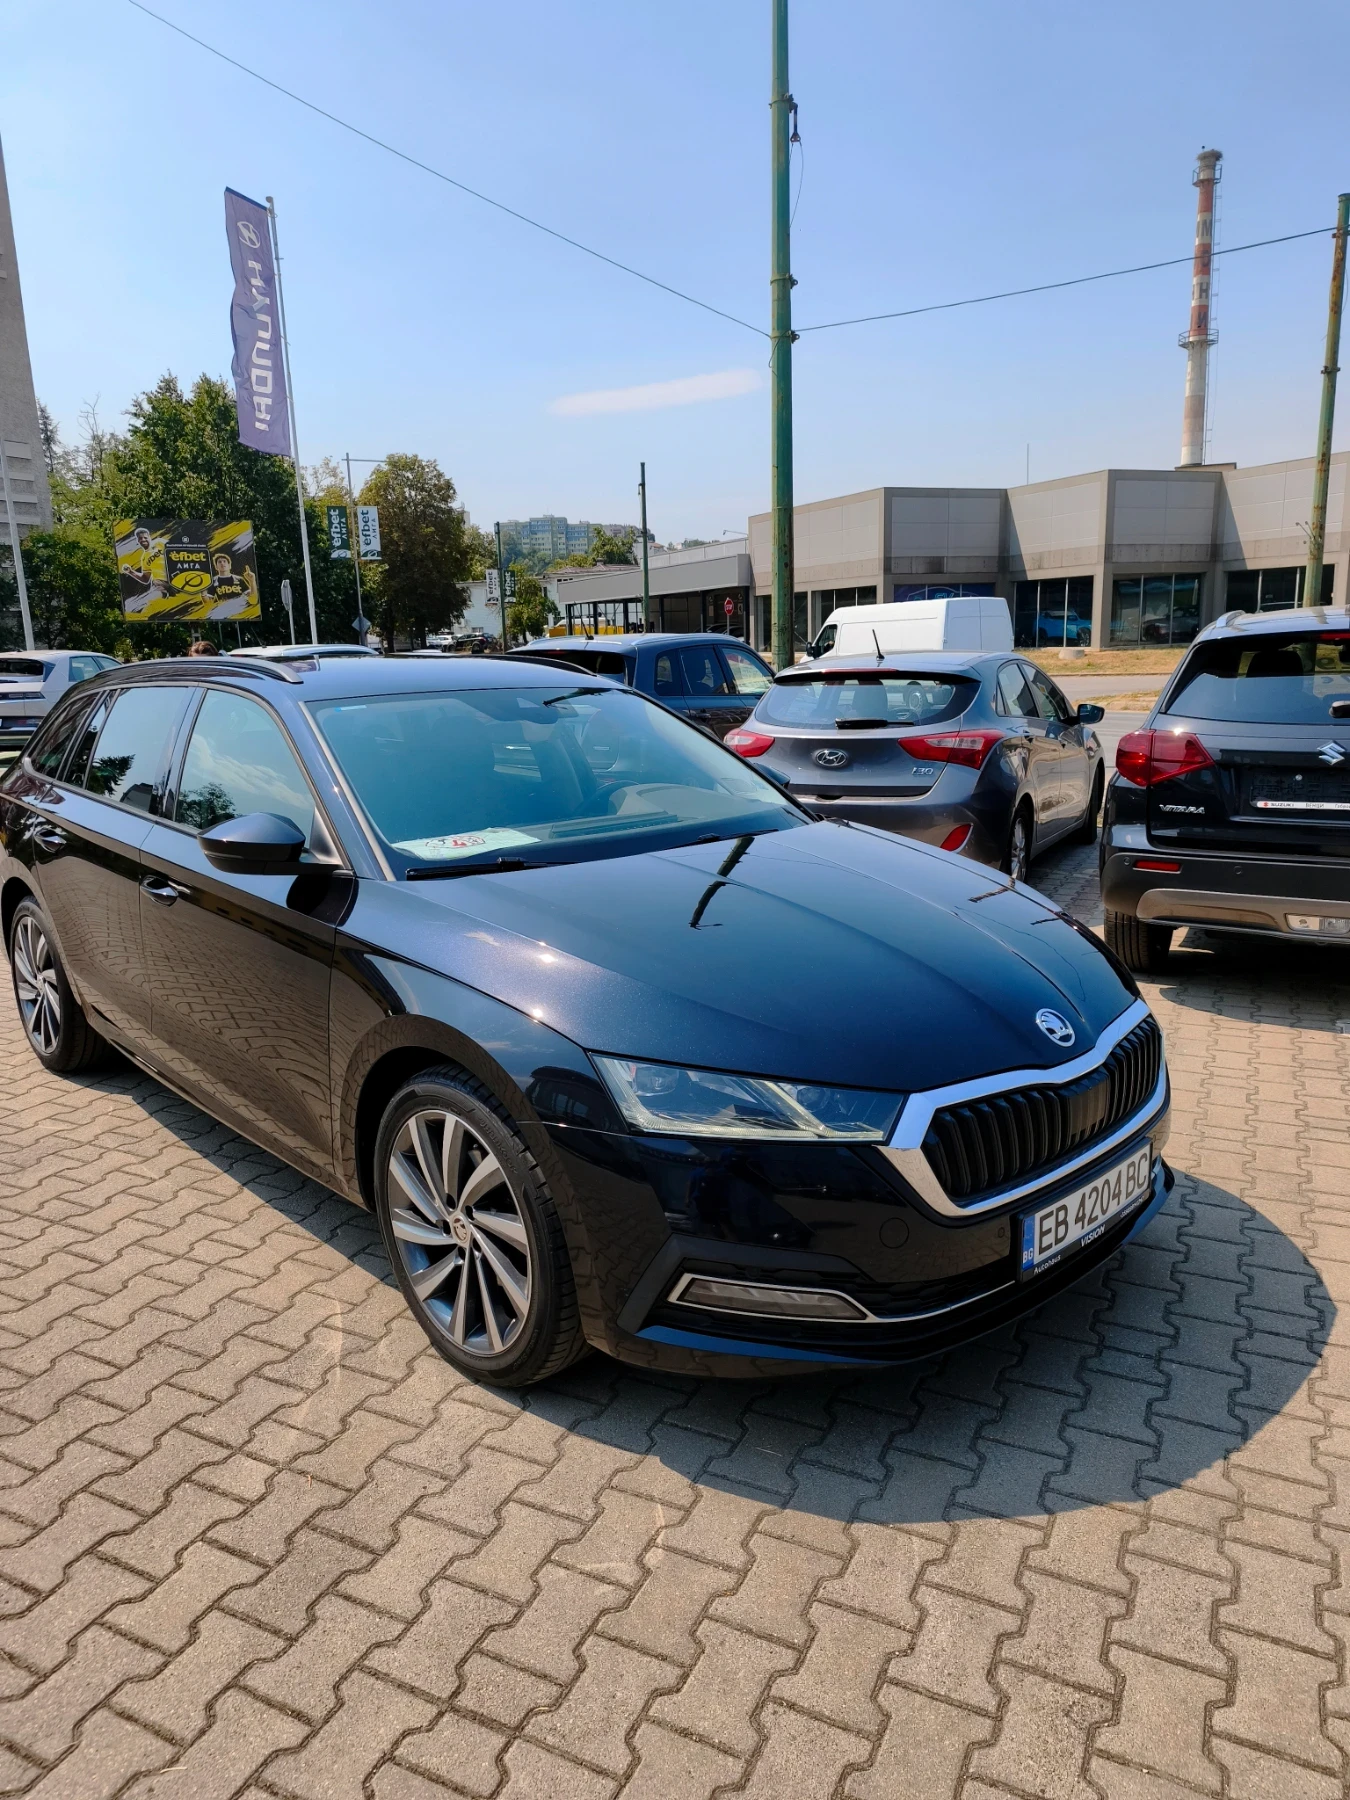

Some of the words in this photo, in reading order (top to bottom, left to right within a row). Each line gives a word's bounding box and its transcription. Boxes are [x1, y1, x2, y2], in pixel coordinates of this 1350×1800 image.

[329, 508, 342, 547] efbet
[361, 509, 372, 546] efbet
[169, 551, 206, 562] efbet
[216, 585, 242, 595] efbet
[1159, 804, 1205, 814] VITARA
[1038, 1204, 1069, 1255] EB
[1074, 1169, 1122, 1231] 4204
[1125, 1152, 1148, 1200] BC
[1080, 1224, 1106, 1247] VISION
[1022, 1247, 1034, 1263] BG
